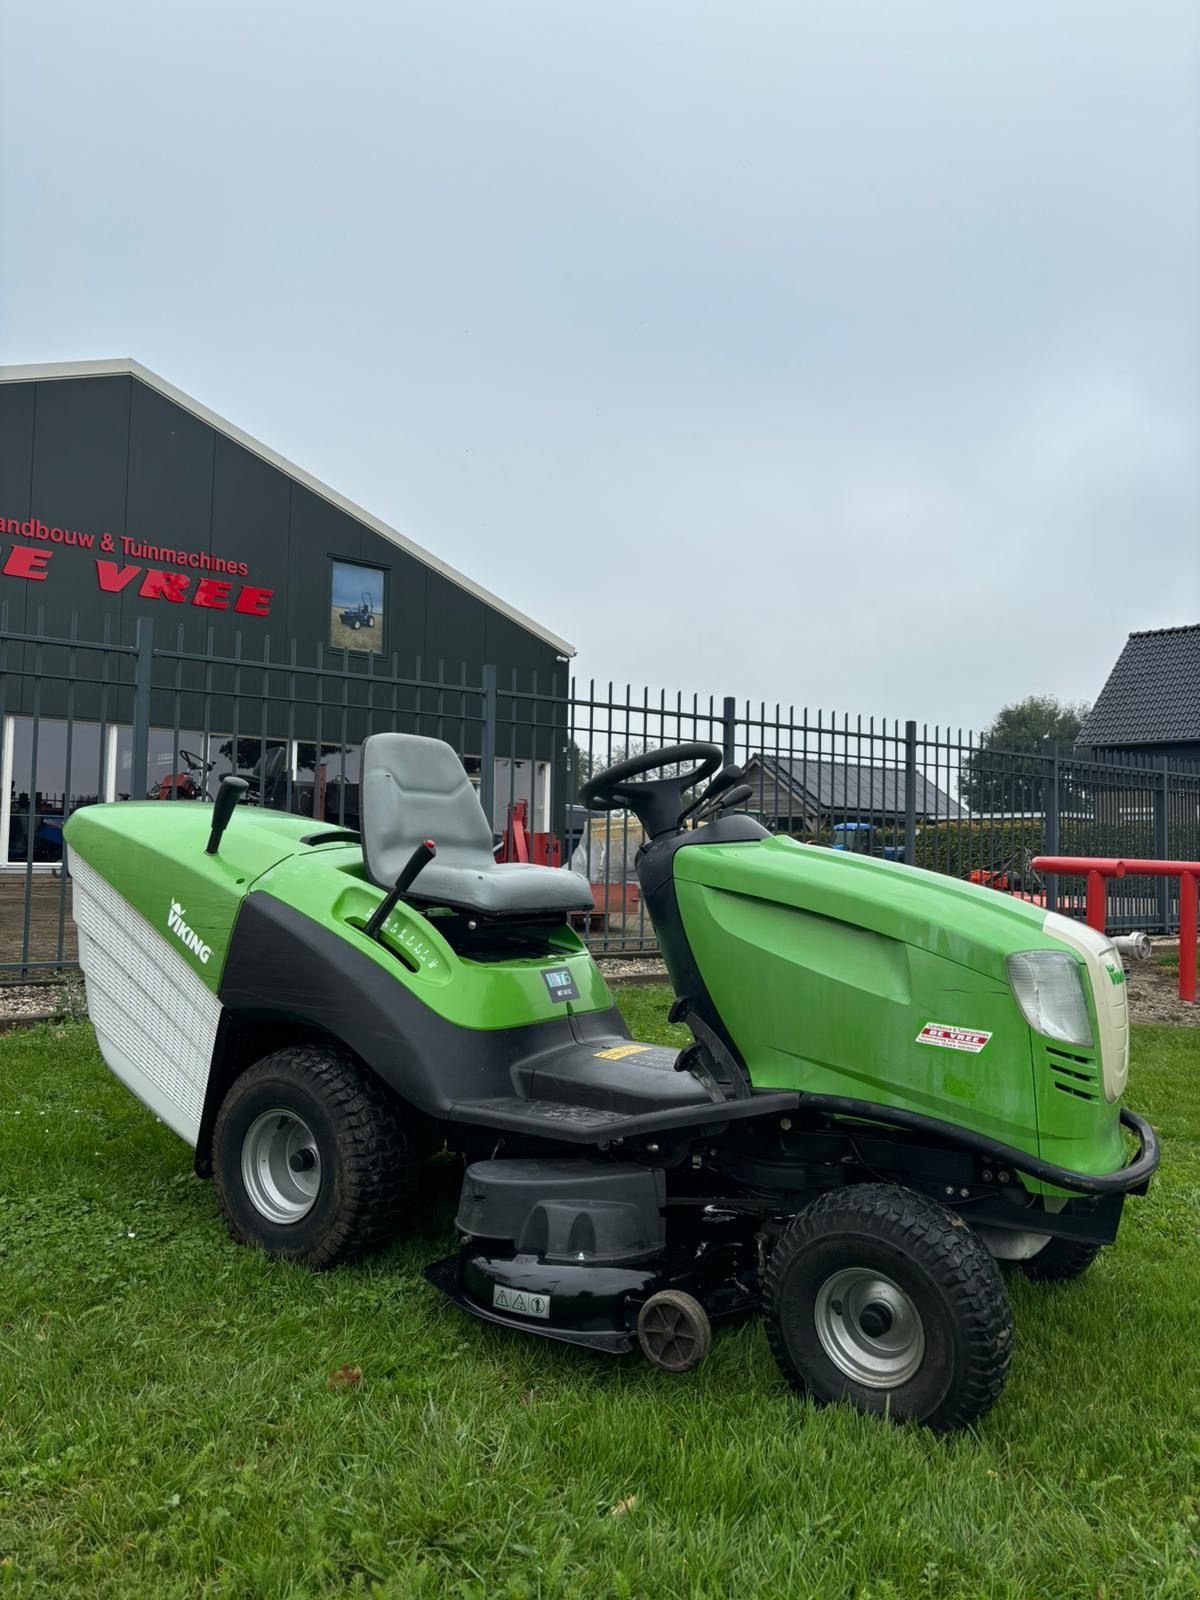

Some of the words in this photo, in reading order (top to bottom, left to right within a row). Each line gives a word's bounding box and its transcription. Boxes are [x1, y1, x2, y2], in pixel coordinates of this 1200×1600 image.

[100, 532, 115, 553] &
[120, 535, 249, 577] Tuinmachines
[0, 544, 54, 581] E
[96, 559, 274, 617] VREE
[167, 907, 212, 965] VIKING
[949, 1032, 980, 1043] VREE
